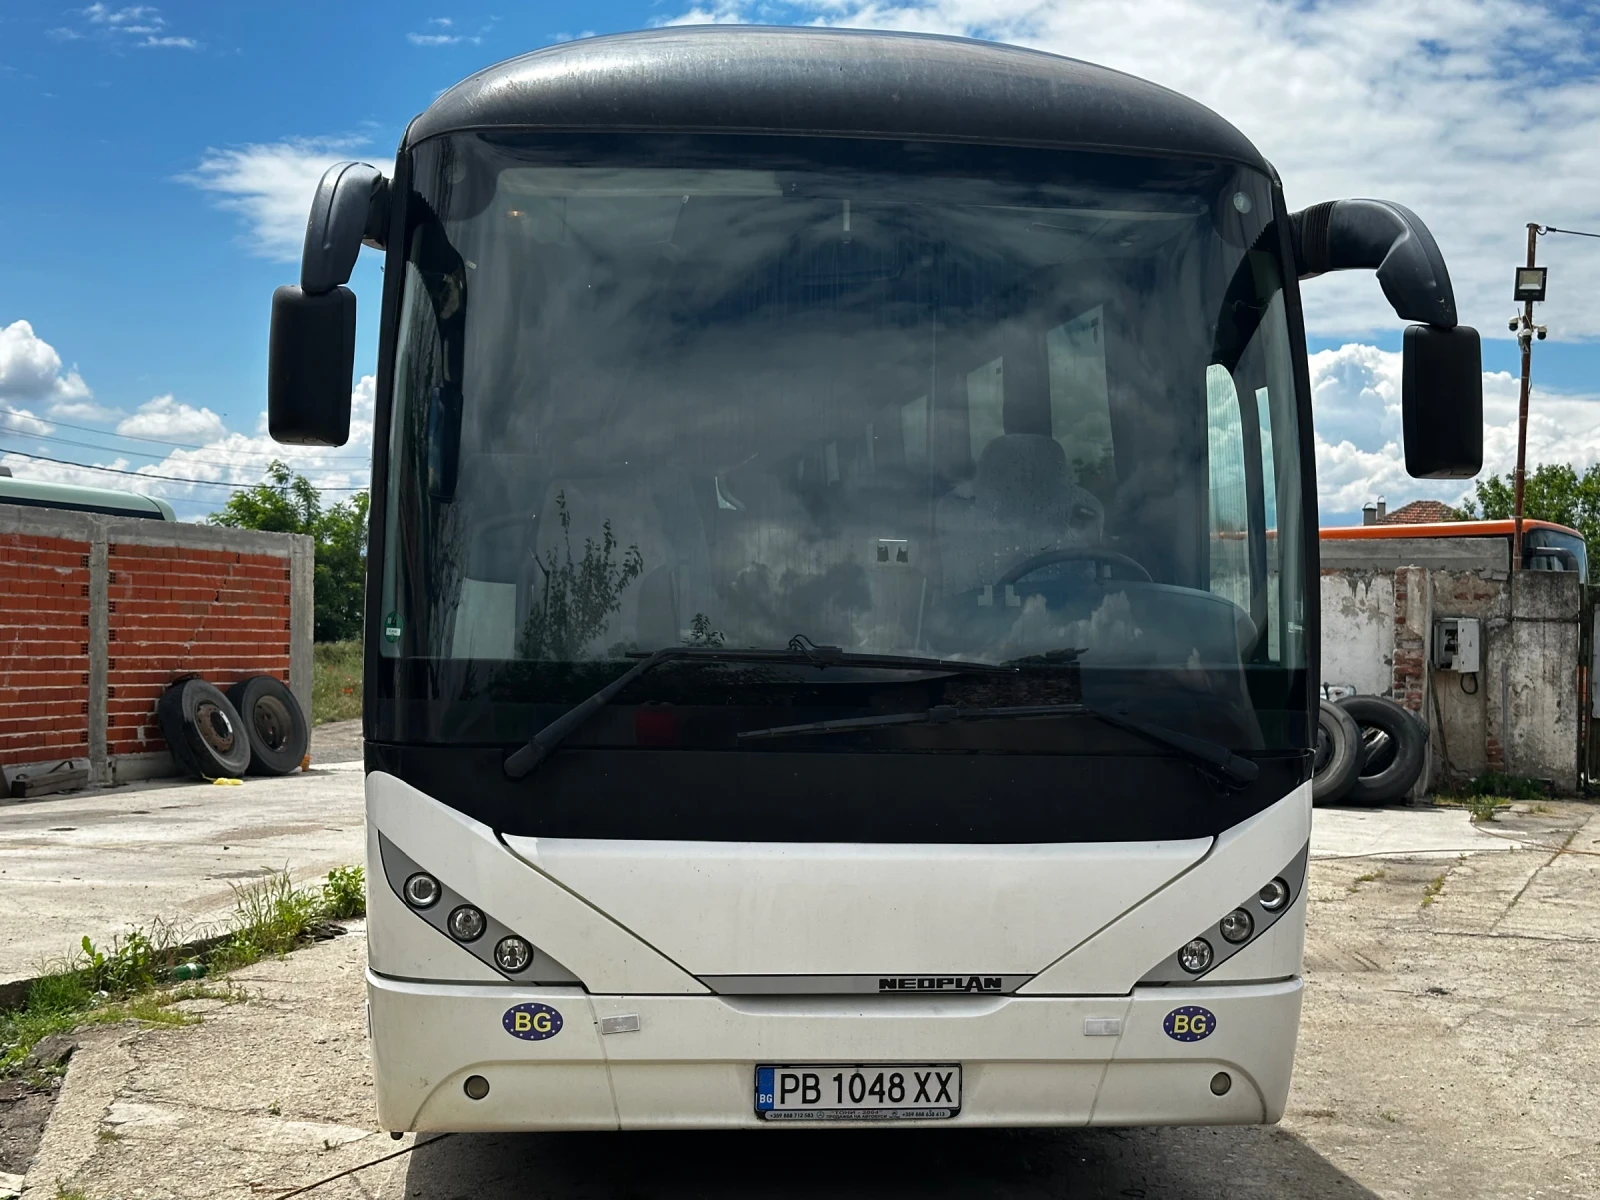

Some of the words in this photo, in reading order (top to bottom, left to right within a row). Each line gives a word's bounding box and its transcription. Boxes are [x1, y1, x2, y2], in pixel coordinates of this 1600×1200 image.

[879, 976, 1001, 992] NEOPLAN
[515, 1011, 551, 1032] BG
[1174, 1014, 1206, 1034] BG
[780, 1073, 821, 1104] PB
[833, 1072, 905, 1104] 1048
[913, 1071, 953, 1103] XX
[759, 1093, 773, 1104] BG
